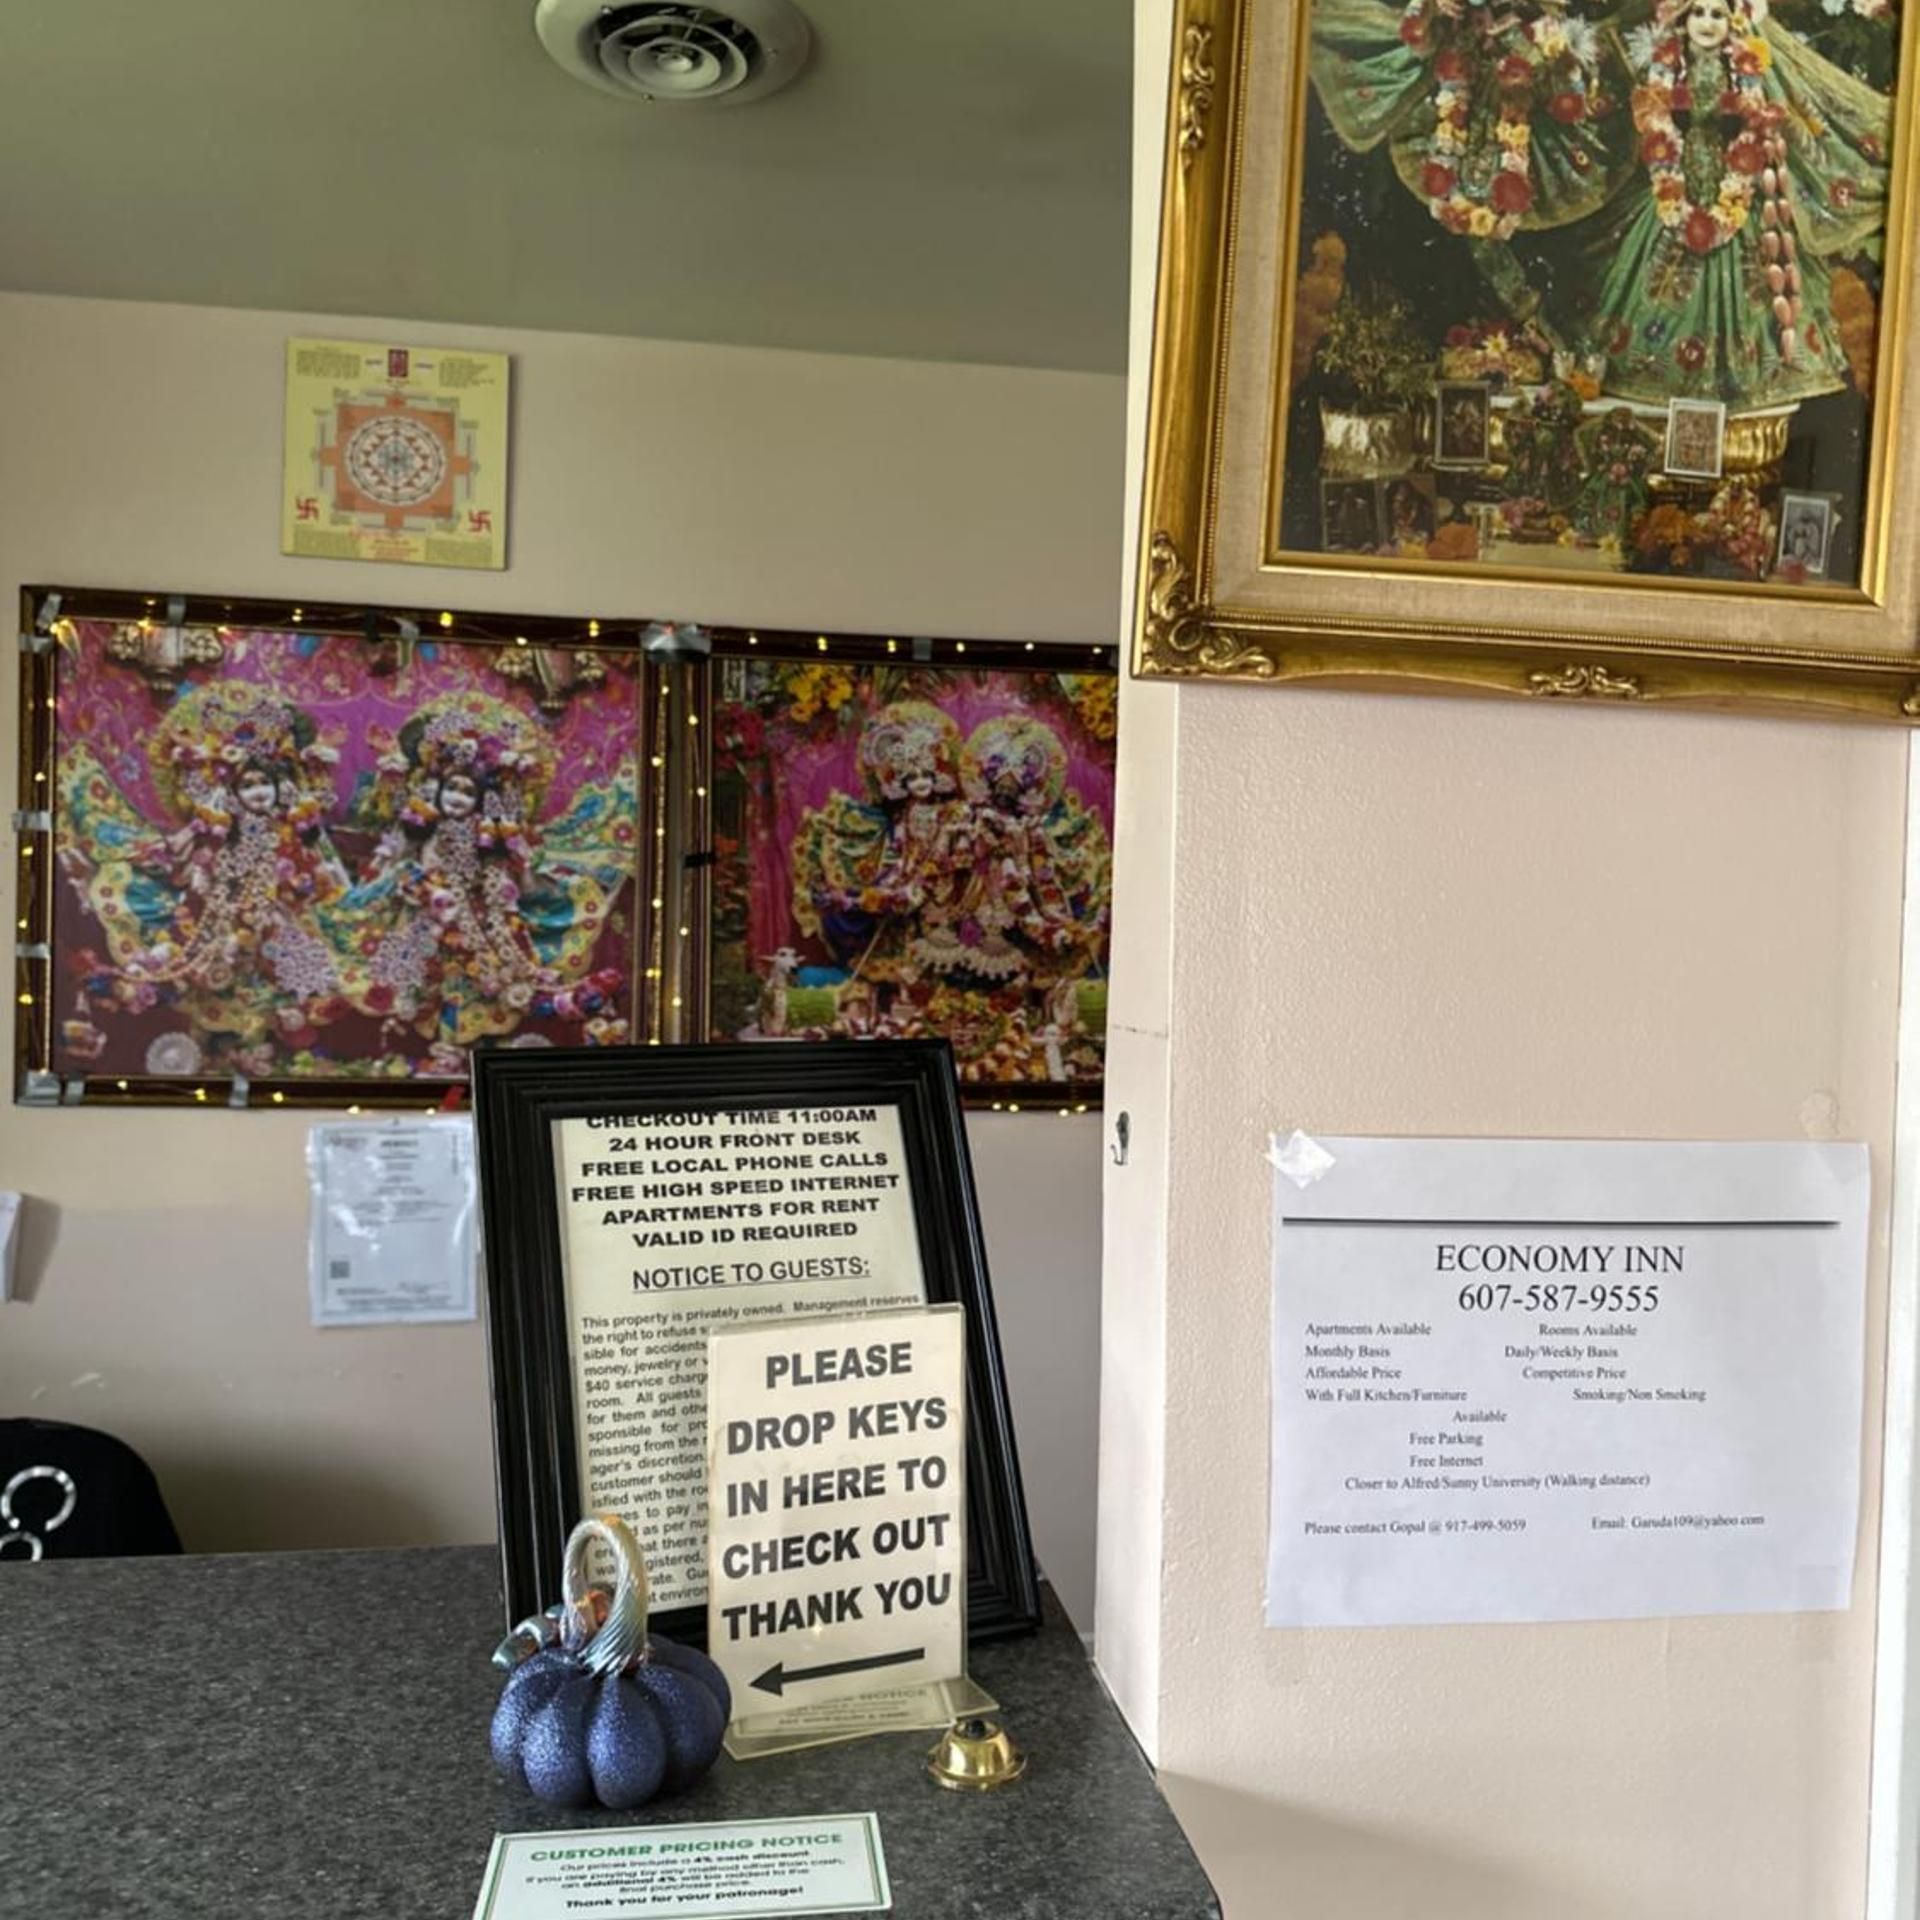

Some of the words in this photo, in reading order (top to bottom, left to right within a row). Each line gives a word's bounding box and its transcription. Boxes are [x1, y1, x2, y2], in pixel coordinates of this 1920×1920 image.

[587, 1112, 718, 1129] CHECKOUT
[728, 1110, 780, 1125] TIME
[788, 1108, 876, 1124] 11:00AM
[609, 1137, 637, 1152] 24
[645, 1135, 713, 1151] HOUR
[720, 1132, 795, 1149] FRONT
[803, 1130, 861, 1146] DESK
[582, 1160, 644, 1177] FREE
[652, 1157, 728, 1174] LOCAL
[736, 1155, 813, 1171] PHONE
[819, 1152, 888, 1168] CALLS
[572, 1185, 635, 1202] FREE
[642, 1182, 703, 1199] HIGH
[710, 1179, 784, 1196] SPEED
[791, 1174, 900, 1192] INTERNET
[602, 1203, 763, 1225] APARTMENTS
[770, 1200, 815, 1216] FOR
[822, 1198, 880, 1213] RENT
[633, 1229, 704, 1248] VALID
[712, 1227, 735, 1244] ID
[742, 1222, 858, 1242] REQUIRED
[1435, 1244, 1615, 1273] ECONOMY
[1625, 1245, 1685, 1273] INN
[633, 1264, 725, 1290] NOTICE
[731, 1261, 764, 1282] TO
[769, 1256, 871, 1280] GUESTS:
[1458, 1283, 1659, 1312] 607-587-9555
[582, 1317, 609, 1328] This
[612, 1312, 669, 1329] property
[672, 1312, 683, 1321] is
[686, 1306, 739, 1322] privately
[793, 1297, 867, 1312] Management
[870, 1294, 919, 1307] reserves
[582, 1333, 604, 1344] the
[607, 1329, 638, 1344] right
[641, 1329, 654, 1340] to
[657, 1326, 697, 1338] refuse
[1305, 1323, 1373, 1338] Apartments
[1376, 1322, 1432, 1336] Available
[1538, 1323, 1580, 1336] Rooms
[1583, 1323, 1638, 1336] Available
[583, 1347, 615, 1360] sible
[620, 1345, 639, 1357] for
[1305, 1345, 1355, 1359] Monthly
[1358, 1345, 1391, 1358] Basis
[1504, 1345, 1585, 1360] Daily/Weekly
[1587, 1345, 1619, 1358] Basis
[634, 1358, 681, 1374] jewelry
[684, 1357, 698, 1368] or
[766, 1342, 912, 1388] PLEASE
[1305, 1366, 1369, 1379] Affordable
[1372, 1366, 1402, 1379] Price
[1522, 1367, 1594, 1381] Competitive
[1597, 1367, 1627, 1379] Price
[585, 1379, 610, 1393] $40
[615, 1376, 664, 1390] service
[668, 1372, 709, 1386] charg
[636, 1392, 653, 1403] All
[658, 1388, 702, 1404] guests
[1305, 1388, 1334, 1401] With
[1337, 1388, 1361, 1401] Full
[1364, 1388, 1468, 1401] Kitchen/Furniture
[1572, 1388, 1652, 1403] Smoking/Non
[1655, 1388, 1707, 1403] Smoking
[587, 1412, 605, 1425] for
[612, 1410, 646, 1423] them
[652, 1405, 677, 1419] and
[1452, 1410, 1508, 1423] Available
[588, 1424, 652, 1442] sponsible
[661, 1421, 680, 1433] for
[727, 1410, 835, 1455] DROP
[848, 1397, 947, 1440] KEYS
[588, 1443, 641, 1457] missing
[644, 1439, 675, 1452] from
[678, 1436, 699, 1448] the
[1409, 1432, 1435, 1446] Free
[1438, 1432, 1484, 1447] Parking
[590, 1460, 632, 1477] ager's
[1409, 1455, 1435, 1467] Free
[1439, 1455, 1484, 1467] Internet
[591, 1474, 654, 1492] customer
[658, 1466, 702, 1483] should
[727, 1479, 768, 1518] IN
[782, 1463, 886, 1509] HERE
[897, 1455, 947, 1493] TO
[1344, 1477, 1383, 1490] Closer
[1385, 1478, 1398, 1490] to
[1482, 1475, 1540, 1490] University
[1544, 1474, 1597, 1490] (Walking
[1599, 1473, 1651, 1487] distance)
[633, 1488, 661, 1503] with
[665, 1486, 687, 1499] the
[646, 1507, 661, 1518] to
[666, 1503, 690, 1518] pay
[643, 1525, 659, 1536] as
[664, 1522, 685, 1535] per
[1304, 1522, 1341, 1535] Please
[1344, 1521, 1386, 1534] contact
[1389, 1521, 1426, 1536] Gopal
[661, 1536, 697, 1550] there
[722, 1526, 860, 1580] CHECK
[872, 1513, 950, 1554] OUT
[722, 1586, 863, 1641] THANK
[873, 1573, 951, 1615] YOU
[530, 1844, 653, 1862] CUSTOMER
[659, 1838, 754, 1854] PRICING
[761, 1833, 842, 1848] NOTICE
[566, 1898, 613, 1909] Thank
[619, 1896, 647, 1906] you
[651, 1895, 673, 1903] for
[676, 1892, 711, 1902] your
[715, 1885, 804, 1900] patronage!
